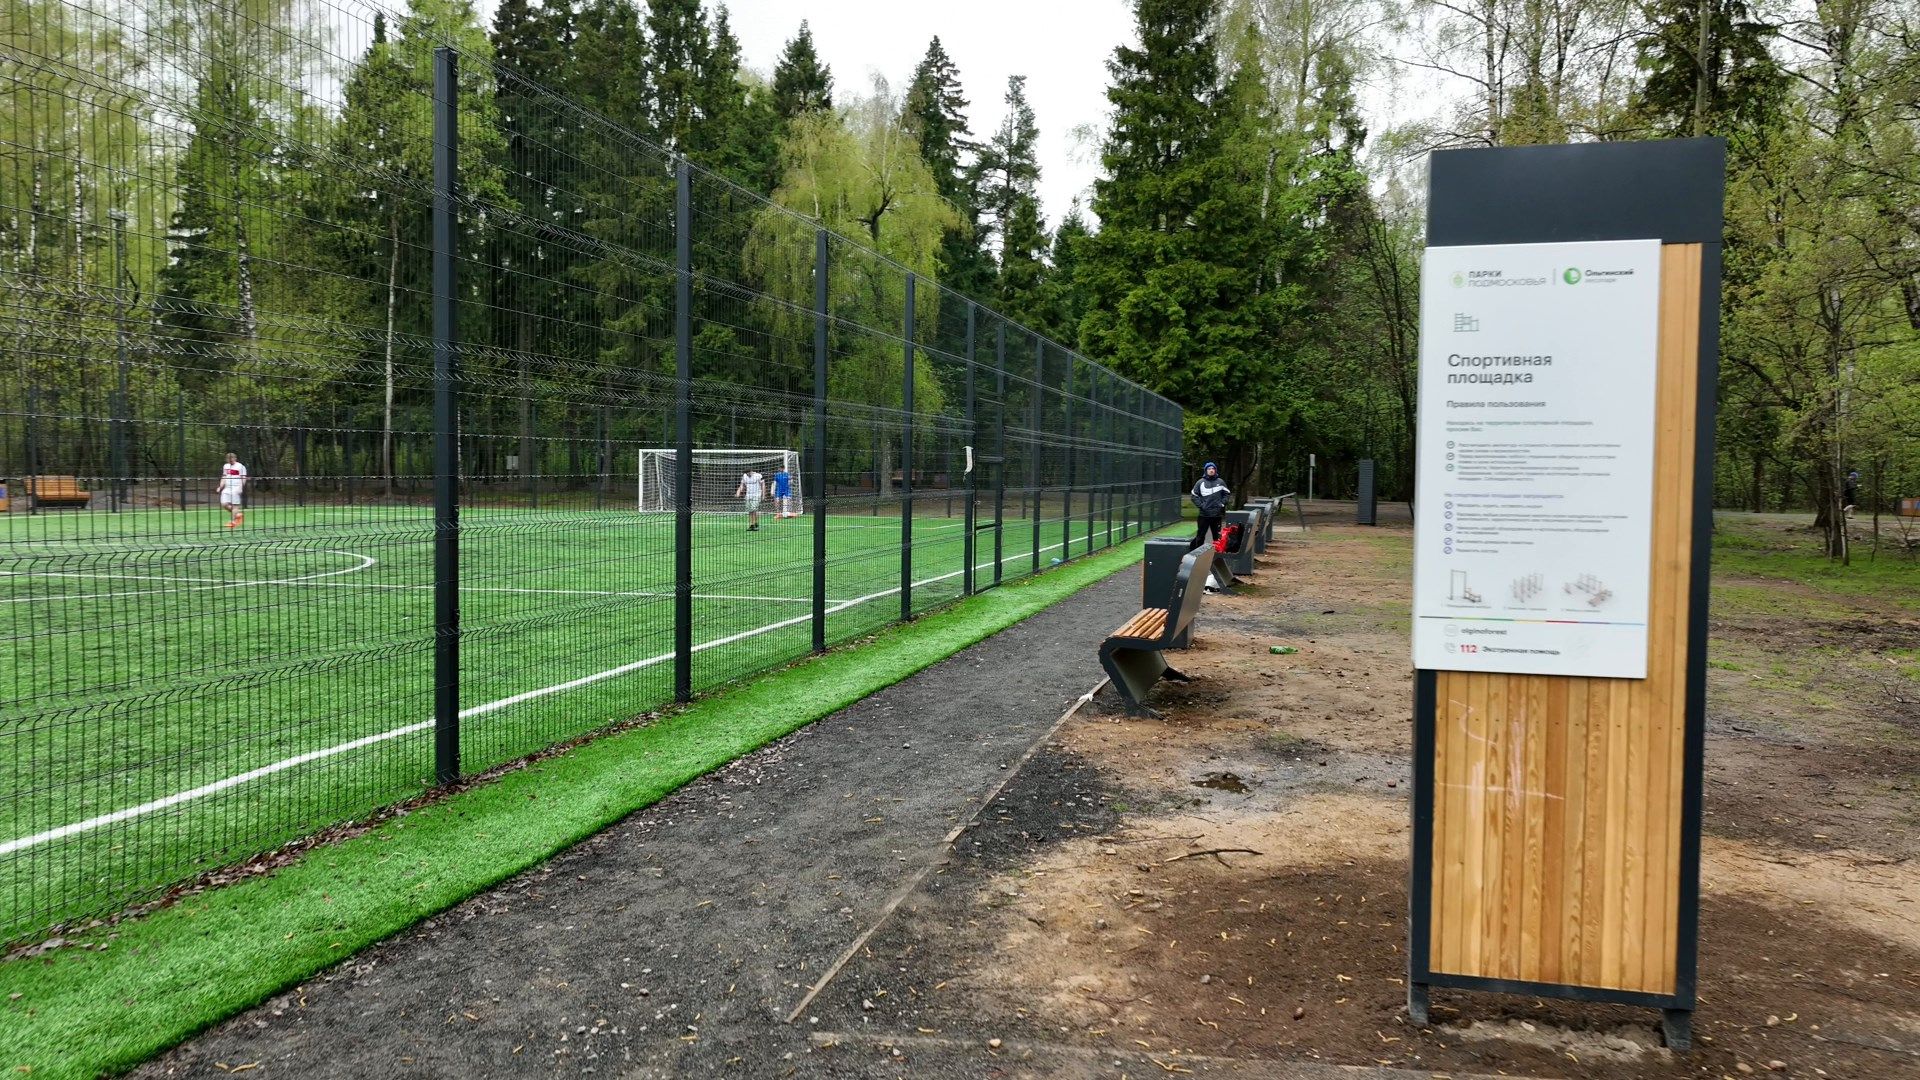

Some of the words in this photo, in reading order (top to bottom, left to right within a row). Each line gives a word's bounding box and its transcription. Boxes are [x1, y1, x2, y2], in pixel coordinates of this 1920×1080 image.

[1468, 270, 1503, 279] ПАРКИ
[1468, 277, 1547, 288] ПОДМОСКОВЬЯ
[1447, 353, 1553, 369] Спортивная
[1447, 372, 1533, 385] площадка
[1446, 400, 1486, 410] Правила
[1487, 400, 1547, 410] пользования
[1460, 643, 1478, 654] 112
[1482, 646, 1529, 655] Экстренная
[1530, 648, 1560, 656] помощь
